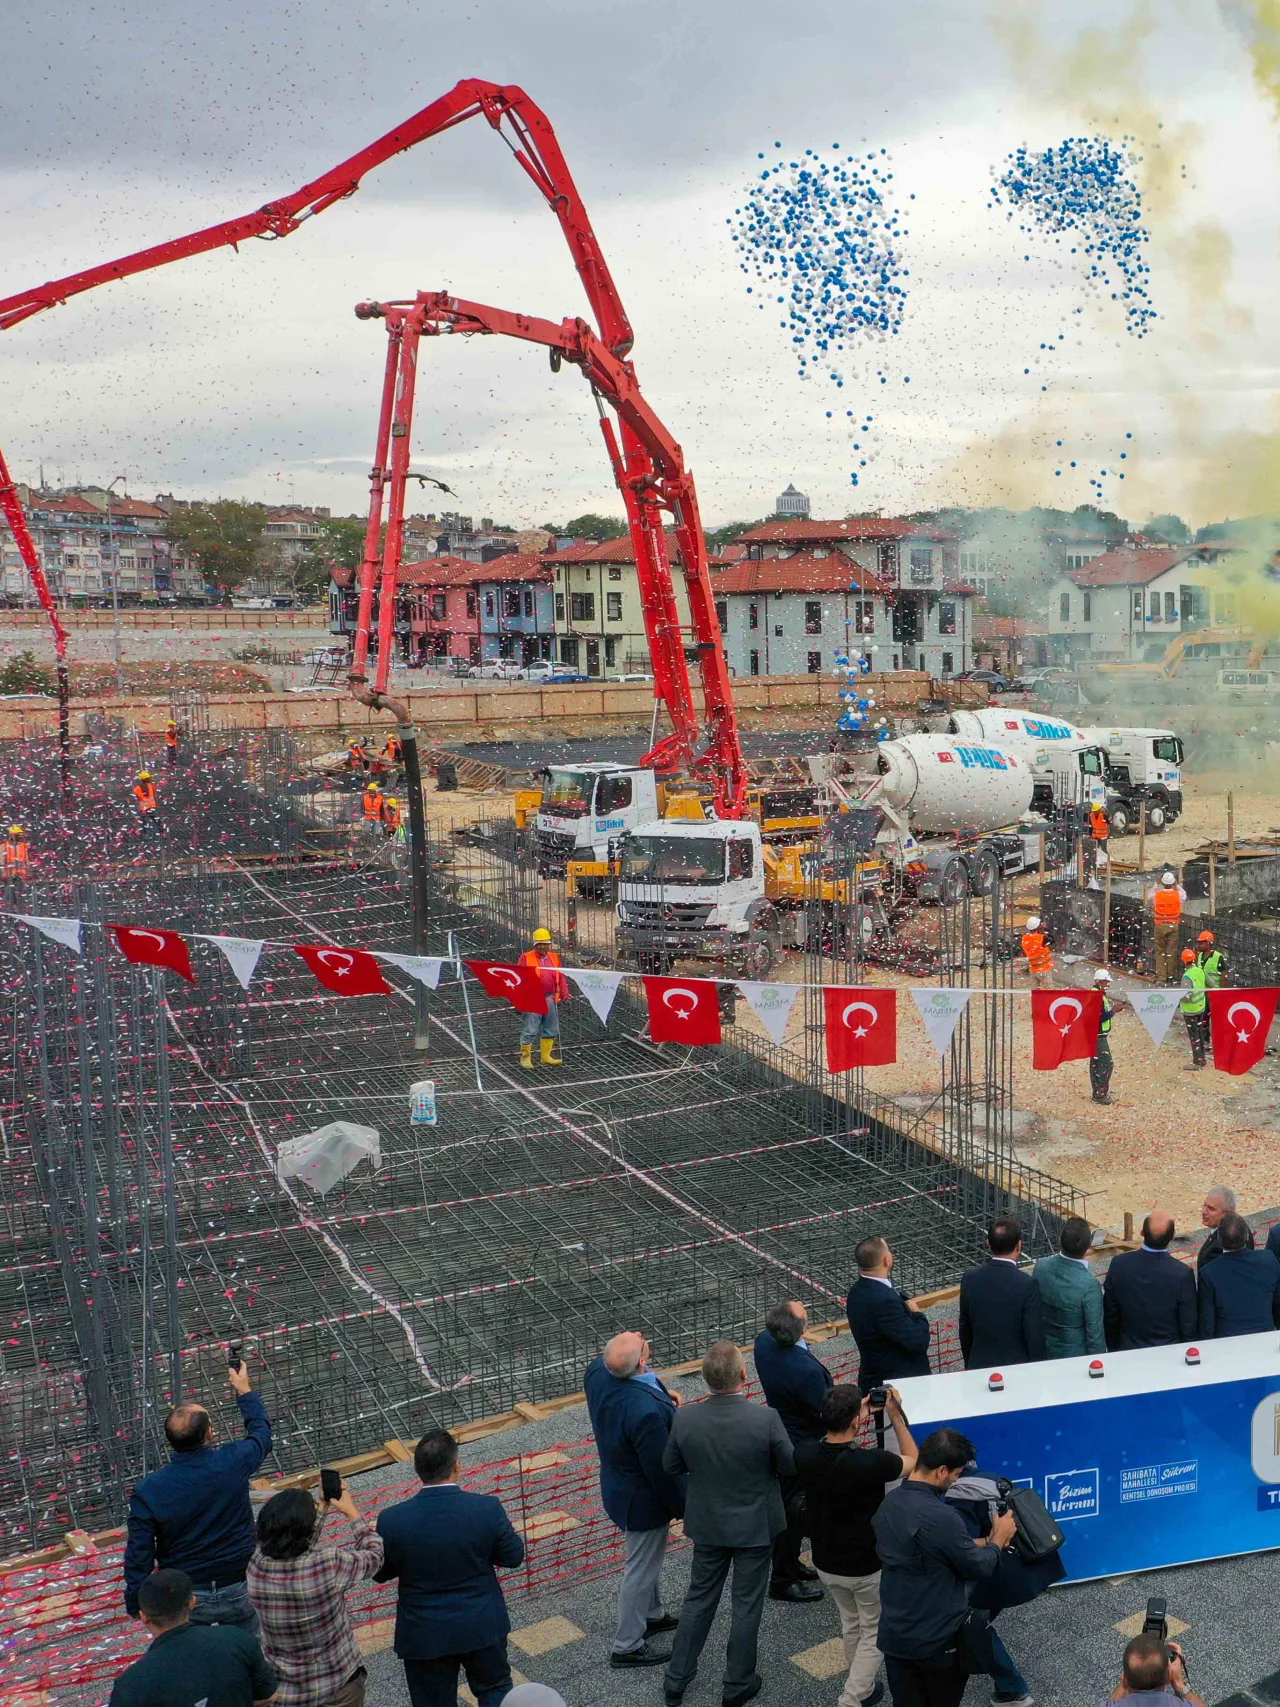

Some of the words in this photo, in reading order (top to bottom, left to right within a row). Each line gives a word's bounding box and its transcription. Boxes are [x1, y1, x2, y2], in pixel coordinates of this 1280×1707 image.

[1058, 1485, 1092, 1500] Bizim
[1123, 1490, 1146, 1501] KENTSEL
[1049, 1498, 1095, 1514] Meram
